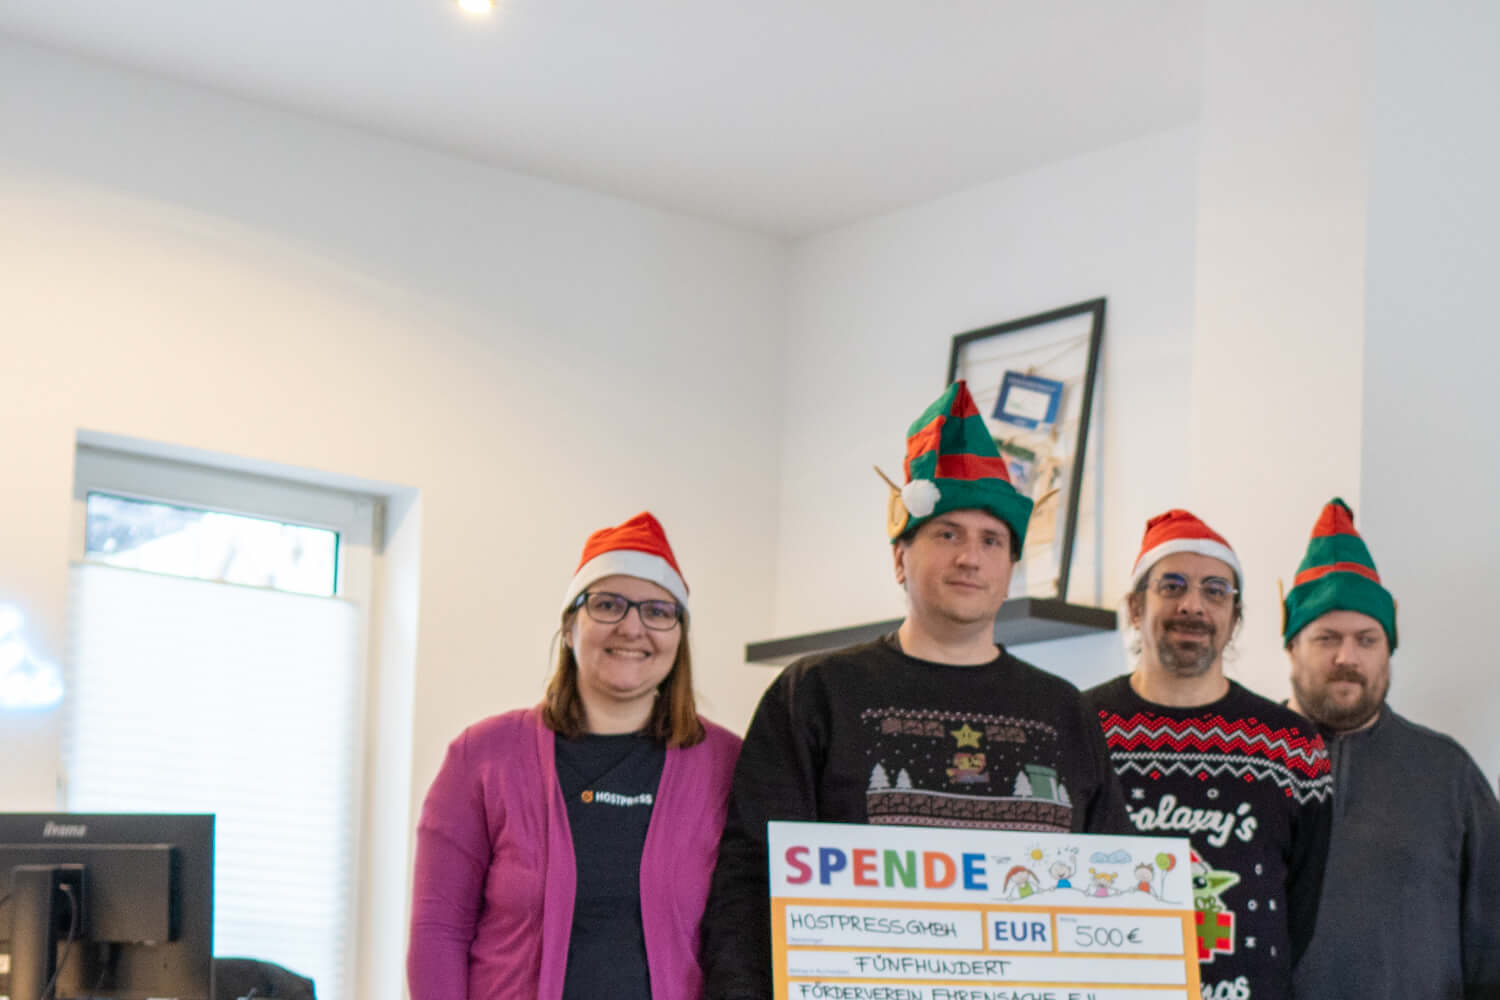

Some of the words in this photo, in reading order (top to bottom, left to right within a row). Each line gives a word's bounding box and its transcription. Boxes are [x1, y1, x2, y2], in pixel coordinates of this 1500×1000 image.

[785, 845, 989, 891] SPENDE
[790, 912, 906, 935] HOSTPRESS
[994, 920, 1047, 942] EUR
[853, 953, 1012, 977] FÜNFHUNDERT
